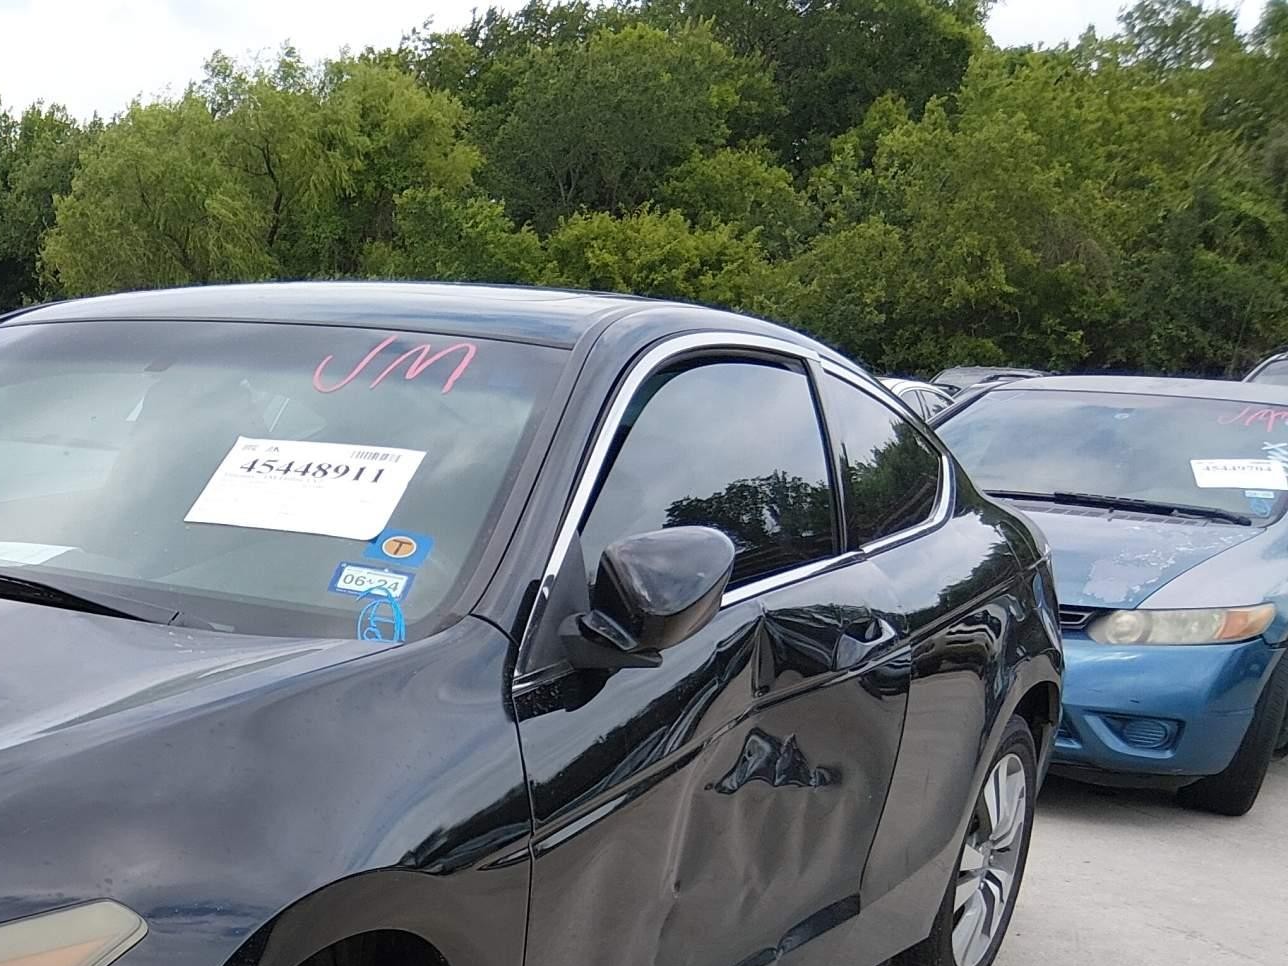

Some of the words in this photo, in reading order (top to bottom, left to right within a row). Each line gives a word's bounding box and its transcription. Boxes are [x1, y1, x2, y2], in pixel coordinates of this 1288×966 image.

[240, 458, 385, 483] 45448911
[392, 539, 413, 555] T
[343, 574, 366, 586] 06
[377, 579, 400, 592] 24
